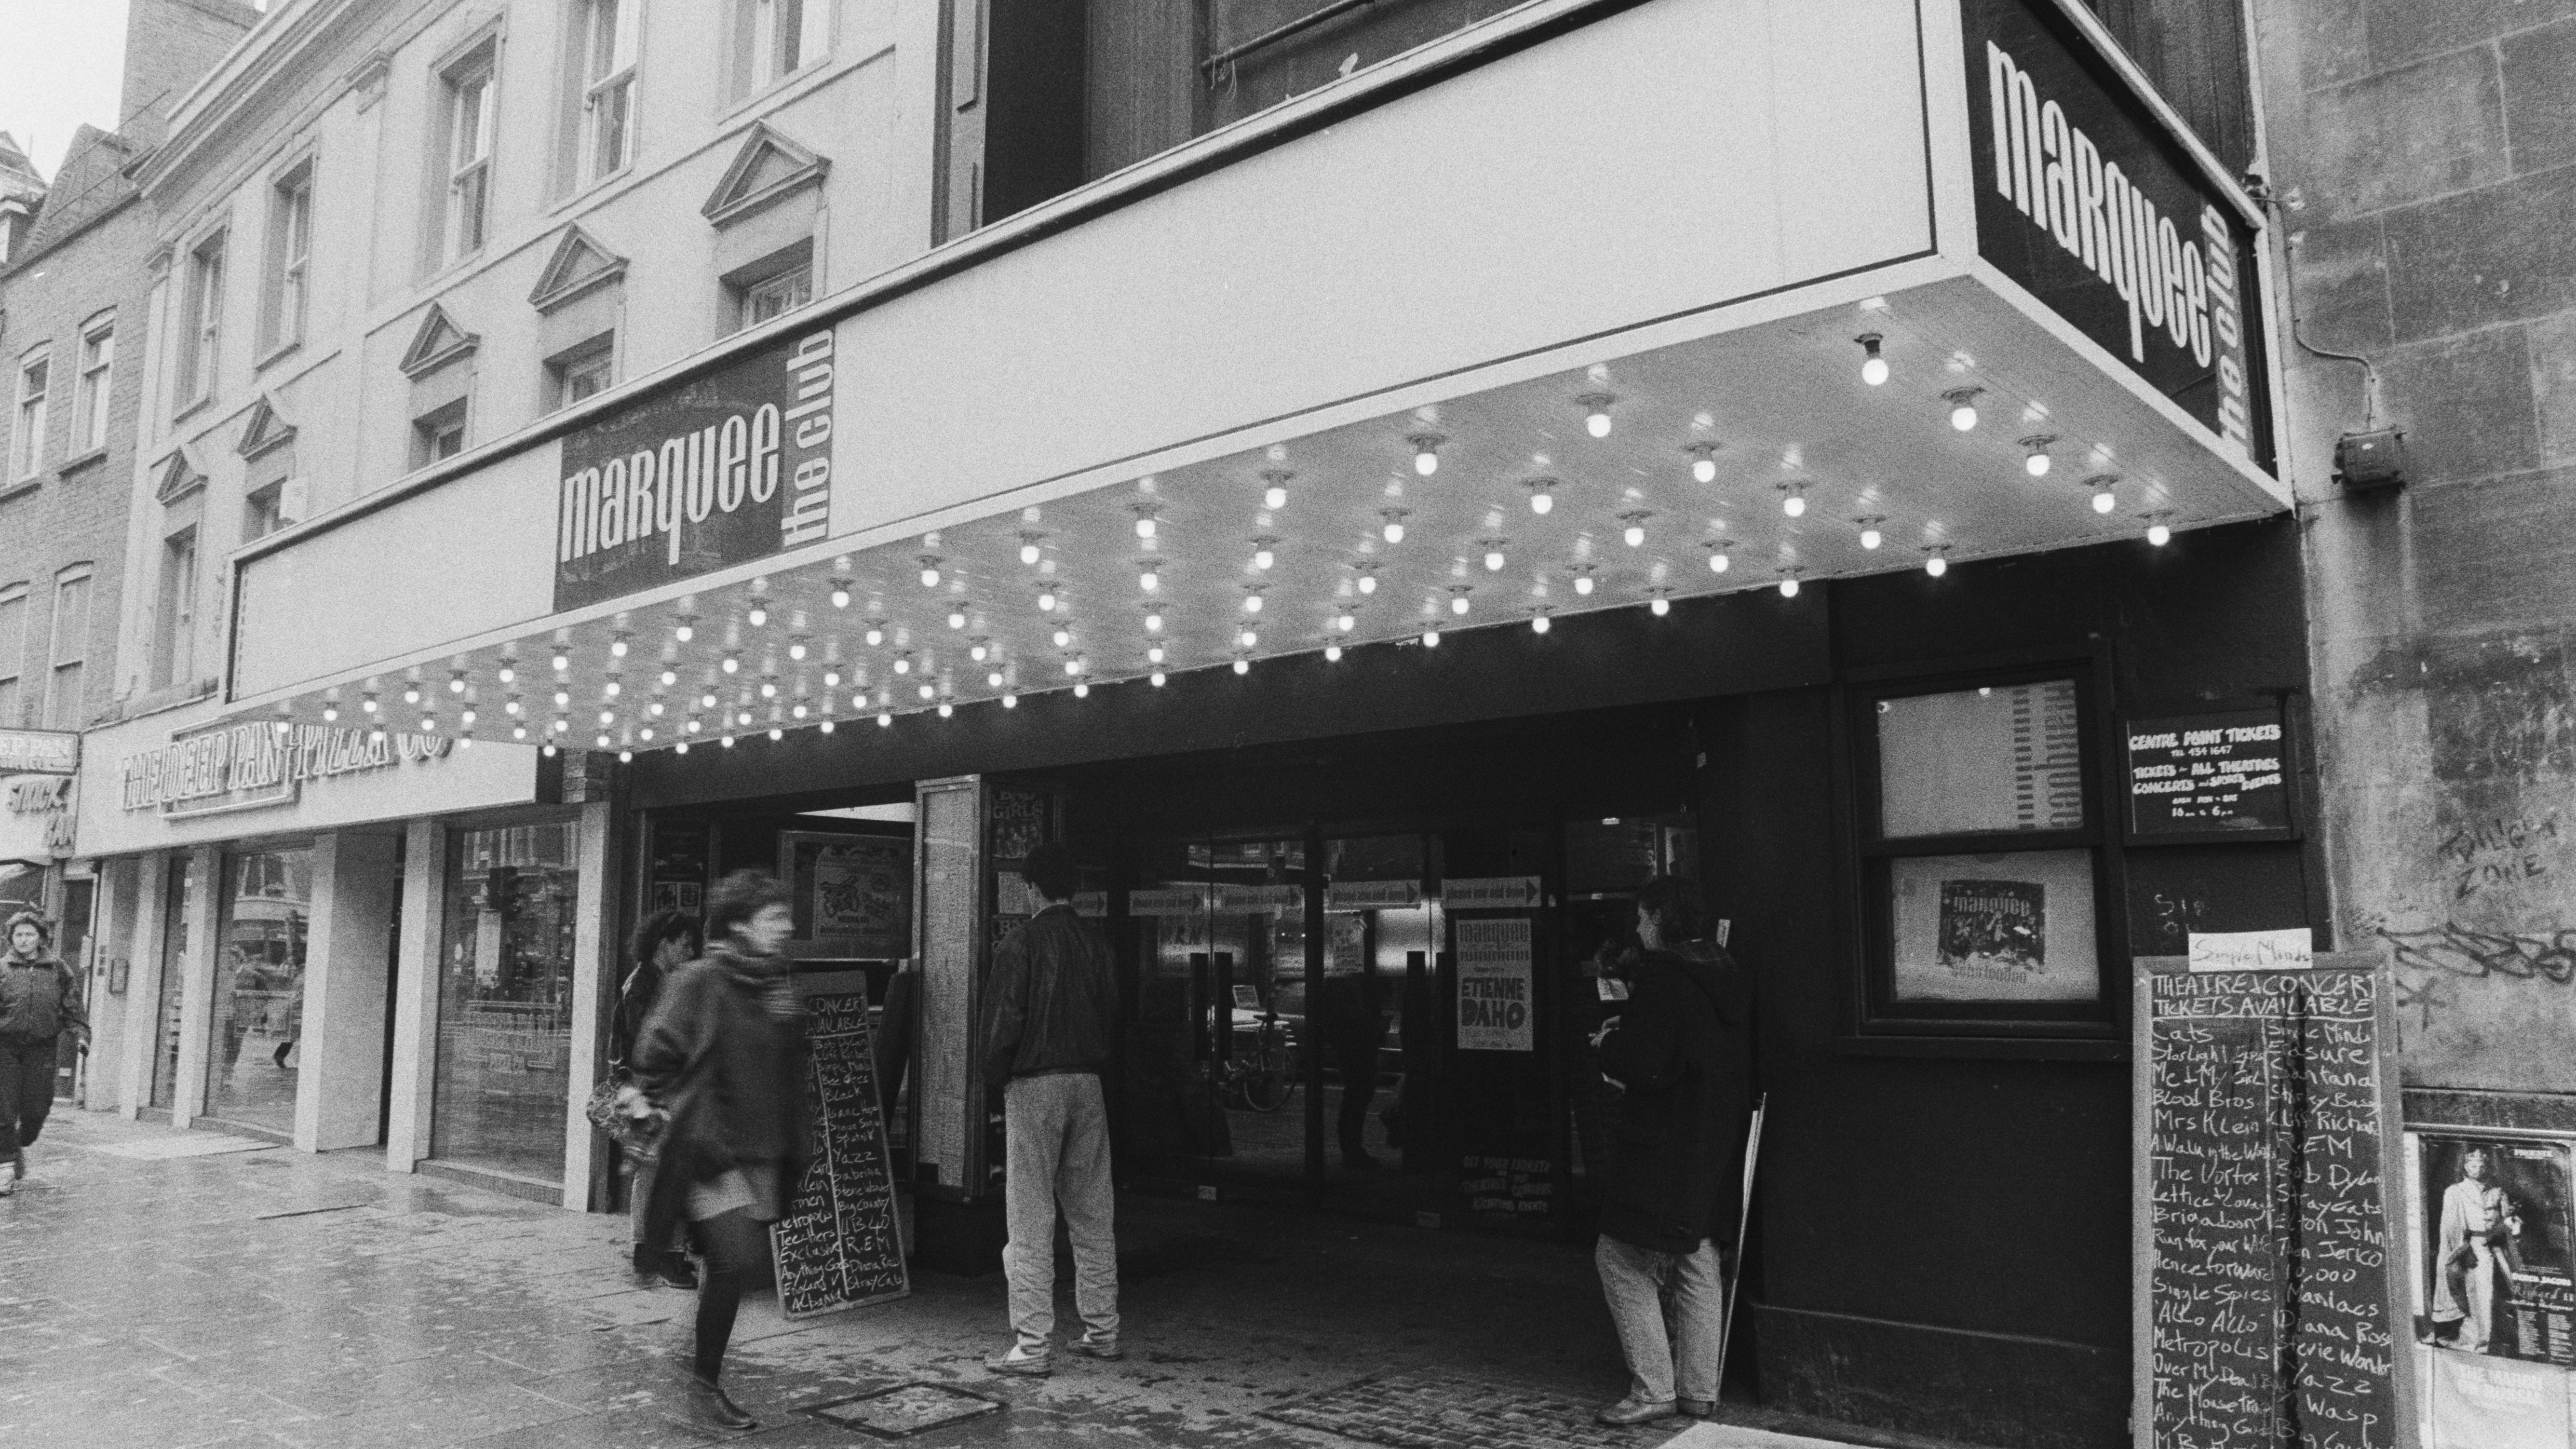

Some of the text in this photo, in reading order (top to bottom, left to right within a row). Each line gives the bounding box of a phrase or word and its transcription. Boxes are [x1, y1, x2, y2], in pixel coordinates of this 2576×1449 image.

[781, 329, 833, 547] the club
[2129, 724, 2282, 751] CENTRE POINT TICKETS
[2188, 747, 2207, 756] 434
[2210, 744, 2232, 755] 1647
[160, 731, 226, 802] DEEP
[226, 721, 284, 791] PAN
[293, 724, 389, 779] PIZZA
[2133, 757, 2281, 779] TICKETS ALL THEATRES
[2133, 779, 2195, 794] CONCERTS
[2457, 853, 2545, 899] ZONE
[1462, 977, 1525, 1000] ETIENNE
[2153, 972, 2248, 997] THEATRE
[2262, 973, 2377, 999] CONCERT
[1462, 999, 1526, 1030] DAHO
[2153, 995, 2372, 1017] TICKETS AVAILABLE
[2152, 1018, 2214, 1044] Cats
[2268, 1040, 2371, 1064] Erasure
[2153, 1087, 2255, 1109] Blood Bros
[2155, 1108, 2259, 1137] Mrs Klein
[2164, 1133, 2204, 1158] Walk
[2152, 1156, 2193, 1182] The
[2275, 1158, 2321, 1184] Bob
[2152, 1180, 2214, 1208] Lettice
[2153, 1227, 2183, 1252] Run
[2334, 1218, 2385, 1247] John
[2152, 1281, 2272, 1318] Single Spies
[2287, 1282, 2379, 1318] Maniacs
[2153, 1325, 2270, 1372] Metropolis
[2154, 1353, 2189, 1377] Over
[2154, 1378, 2183, 1399] The
[2306, 1393, 2378, 1447] Wasp
